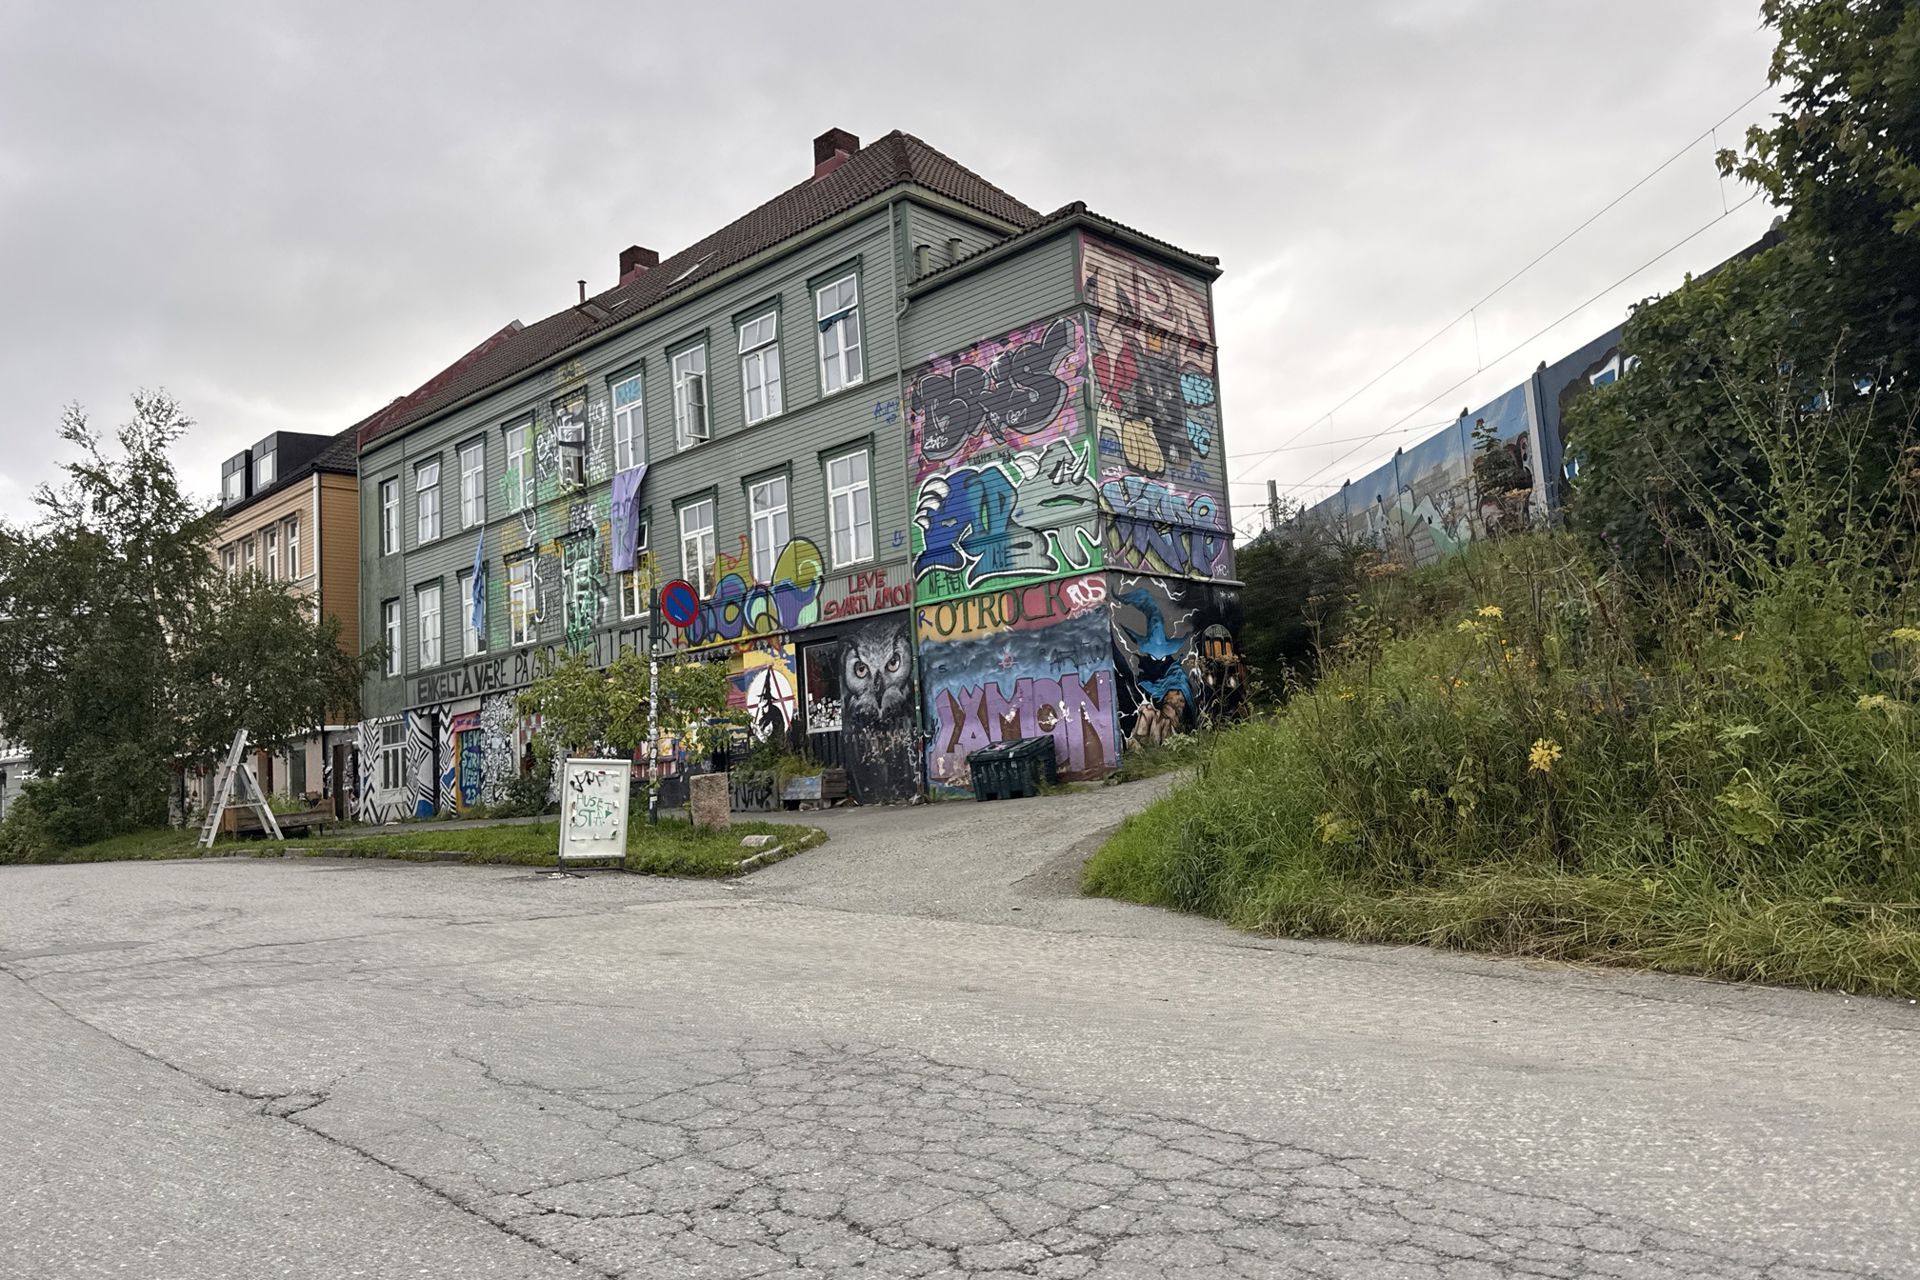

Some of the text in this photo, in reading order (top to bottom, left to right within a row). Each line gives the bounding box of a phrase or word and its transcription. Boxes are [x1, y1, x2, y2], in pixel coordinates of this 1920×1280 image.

[847, 568, 887, 594] LEVE
[418, 671, 461, 703] ENKELT
[474, 659, 509, 691] VÆRE
[514, 649, 529, 684] PÅ
[576, 794, 612, 811] HUSET
